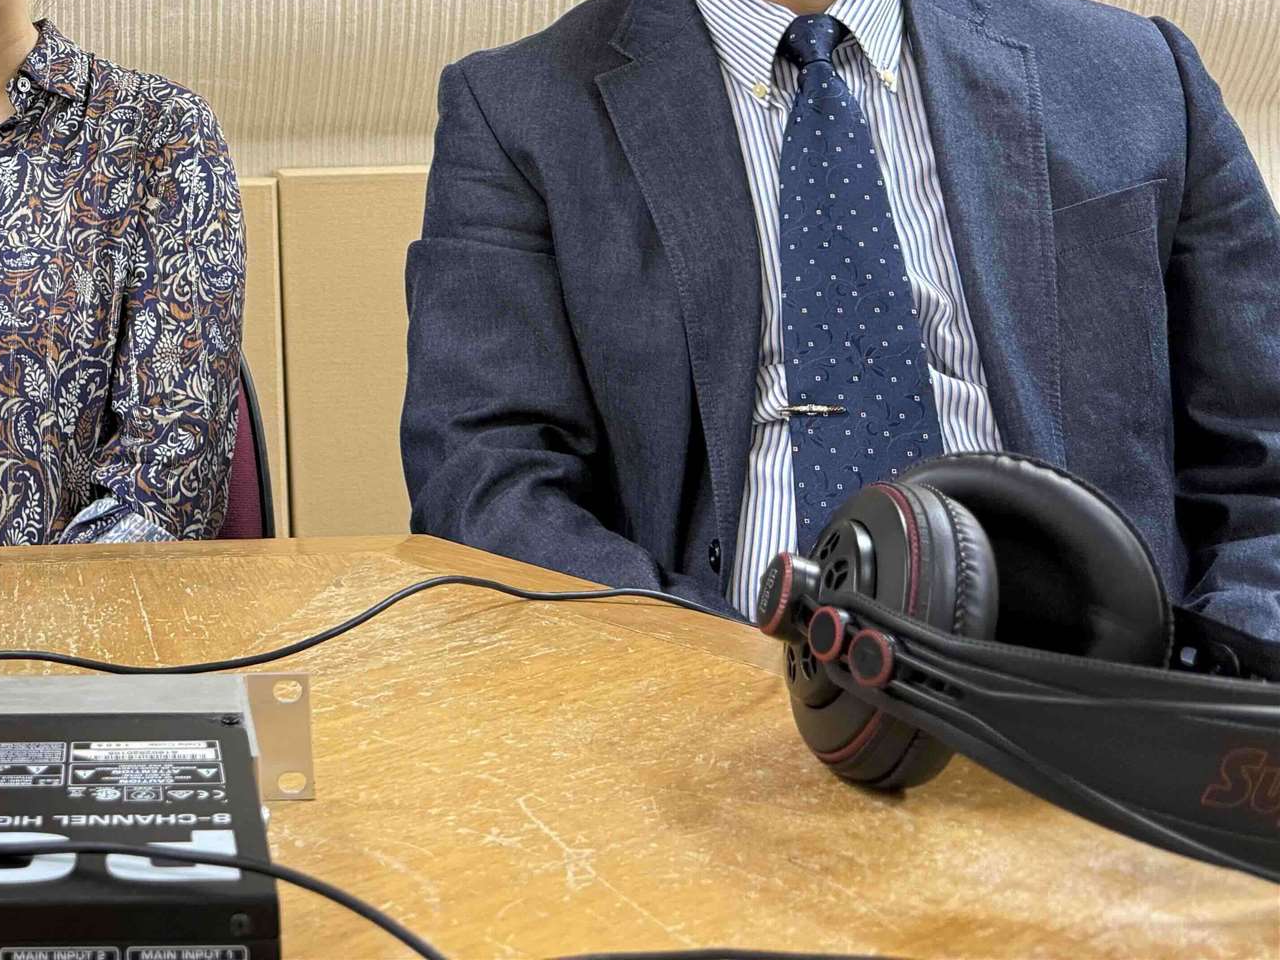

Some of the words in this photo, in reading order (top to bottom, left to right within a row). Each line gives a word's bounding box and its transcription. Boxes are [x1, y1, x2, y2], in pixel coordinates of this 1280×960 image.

[53, 813, 231, 826] 8-CHANNEL
[13, 950, 49, 960] MAIN
[53, 950, 92, 960] INPUT
[140, 950, 177, 960] MAIN
[181, 950, 220, 960] INPUT
